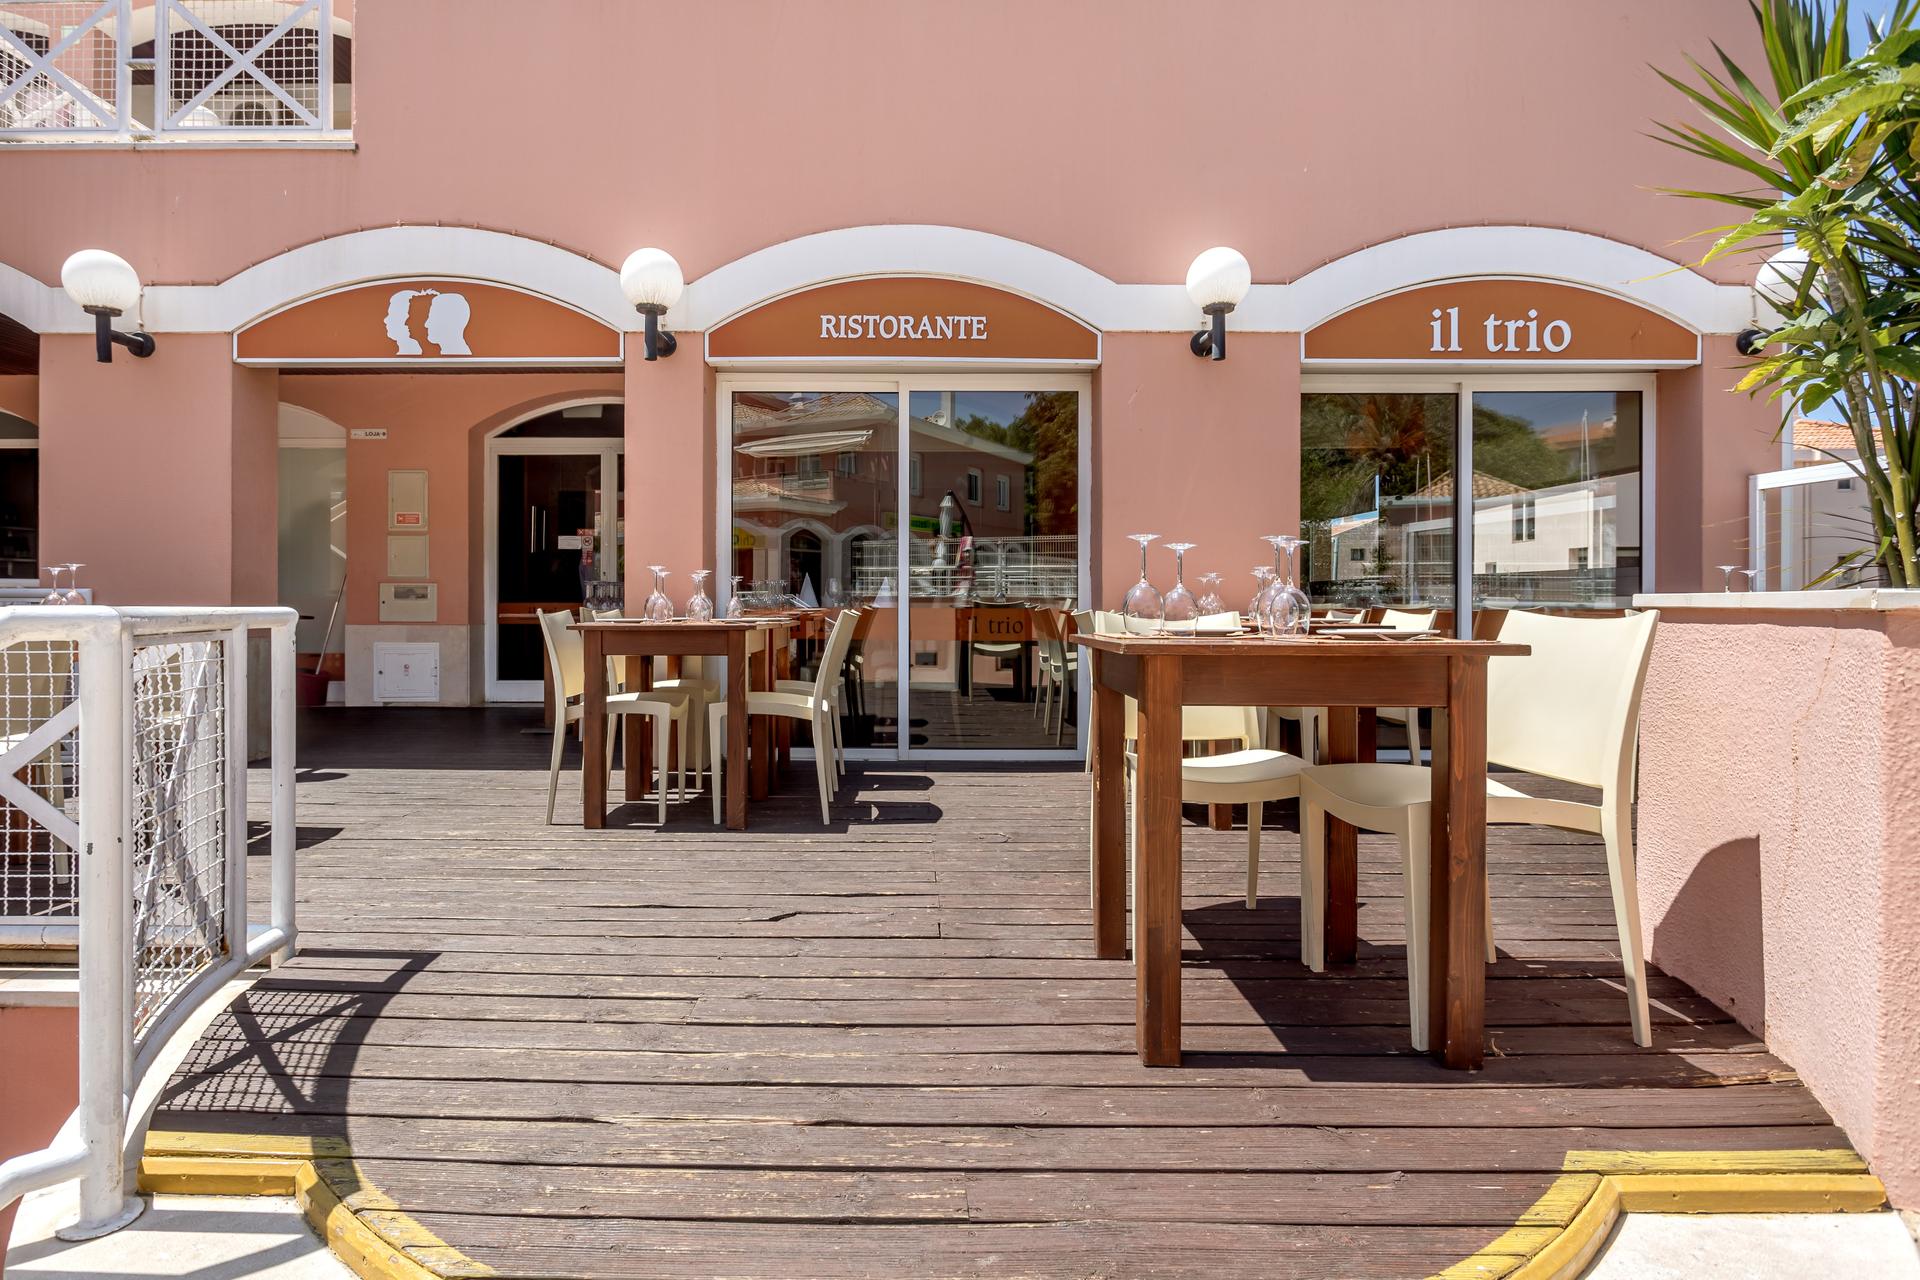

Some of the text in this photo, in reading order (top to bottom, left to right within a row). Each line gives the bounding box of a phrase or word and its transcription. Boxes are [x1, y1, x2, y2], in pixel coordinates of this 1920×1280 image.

[819, 314, 988, 340] RISTORANTE
[1429, 306, 1572, 353] il trio
[988, 617, 1024, 634] trio
